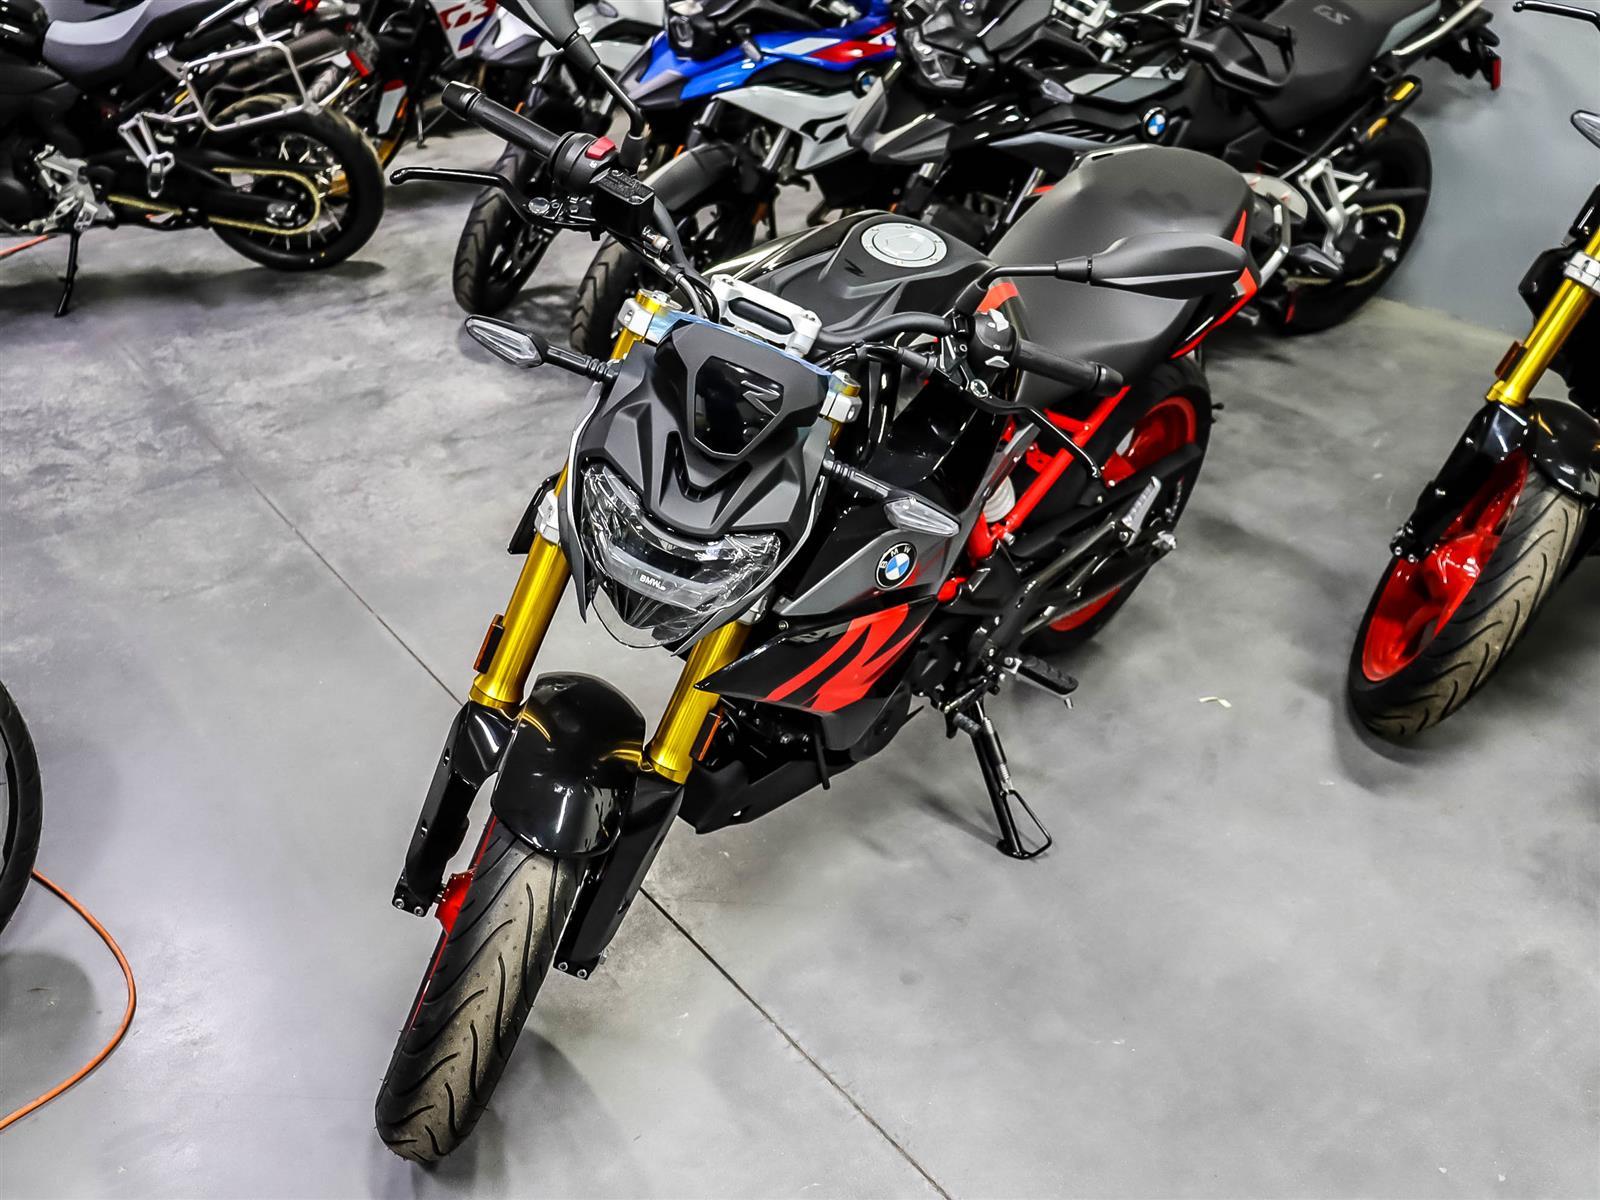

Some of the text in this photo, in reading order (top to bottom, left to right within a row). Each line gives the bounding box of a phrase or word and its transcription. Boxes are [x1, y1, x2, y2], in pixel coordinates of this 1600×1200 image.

[1313, 4, 1351, 25] GS
[880, 545, 911, 569] BMW
[640, 574, 662, 589] BMW
